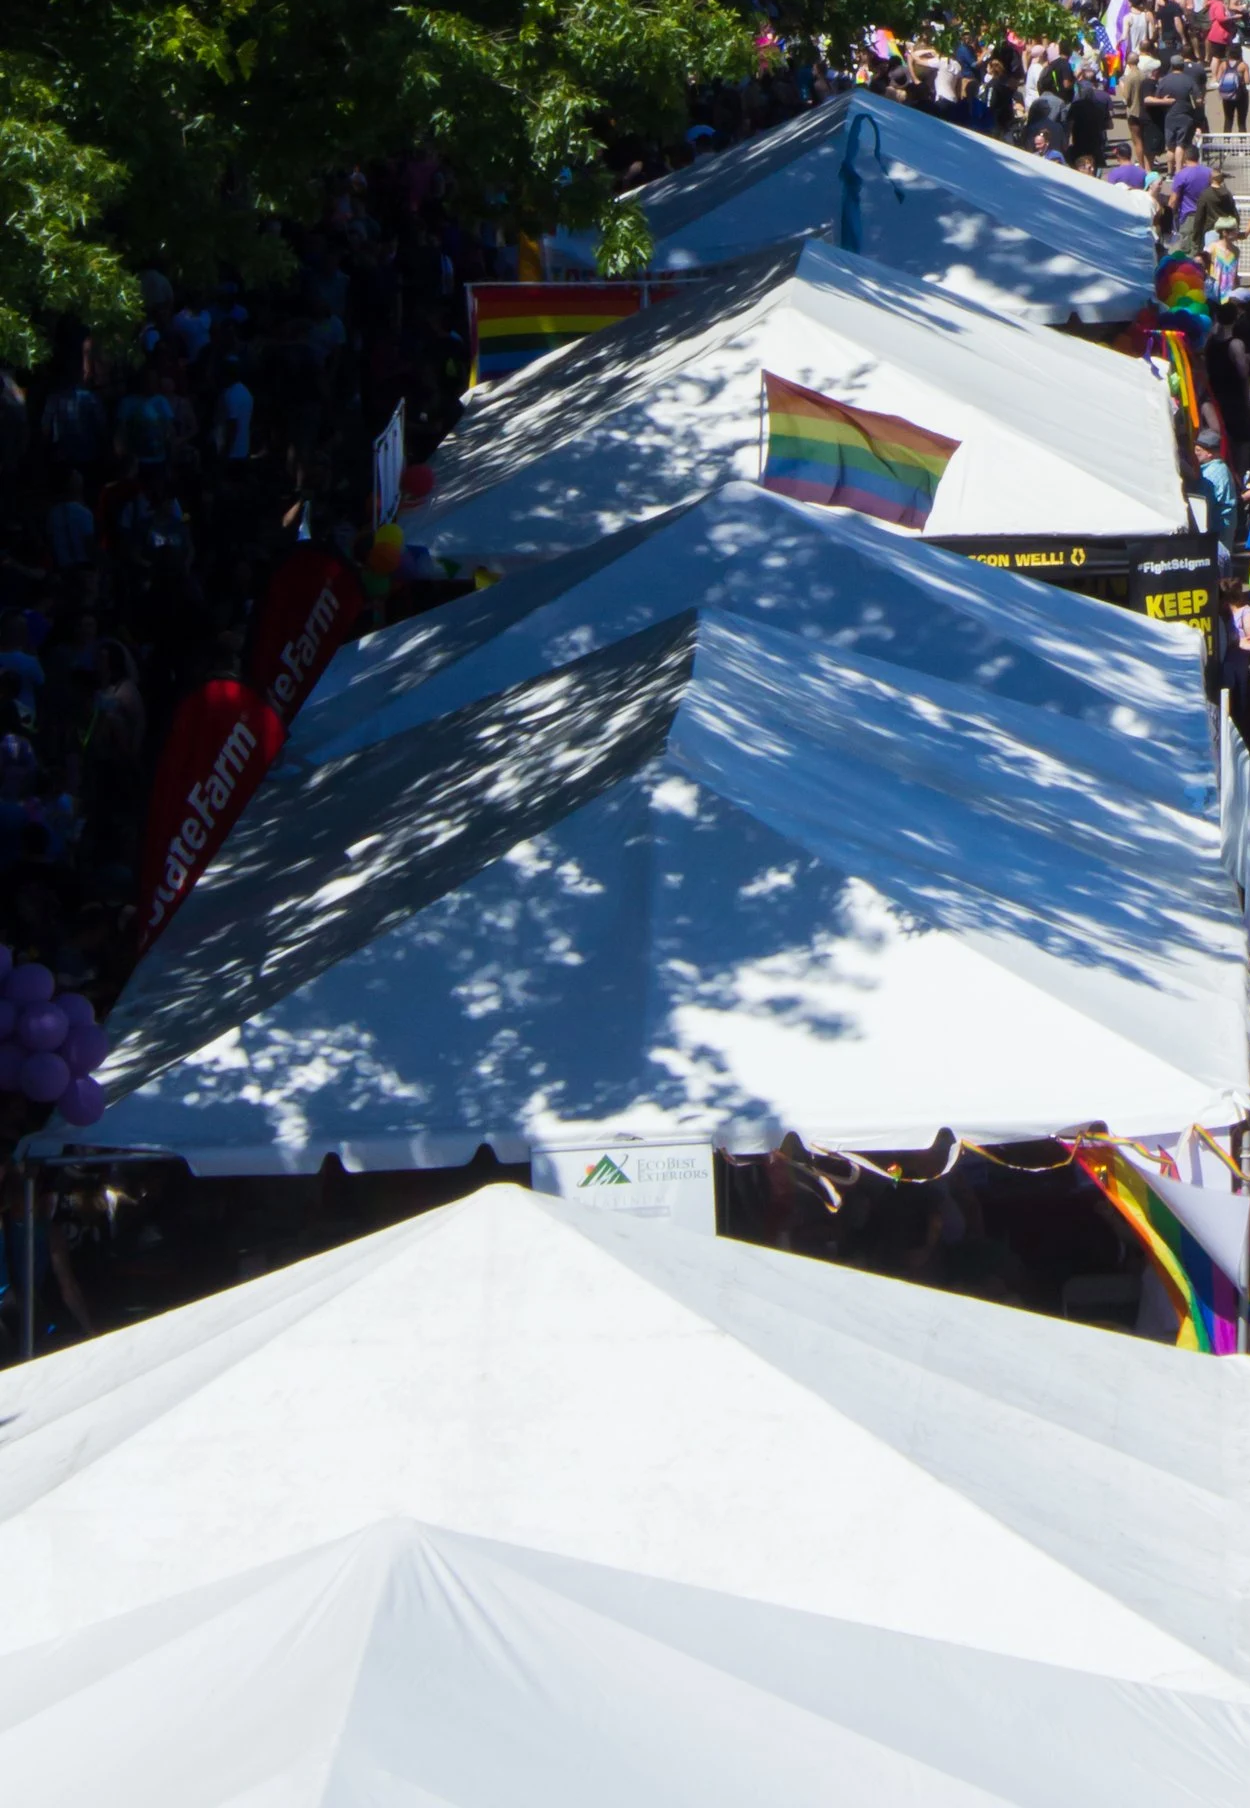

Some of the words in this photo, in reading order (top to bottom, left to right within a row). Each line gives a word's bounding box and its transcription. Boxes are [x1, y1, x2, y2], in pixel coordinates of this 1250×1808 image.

[967, 553, 1010, 567] GON
[1014, 551, 1064, 567] WELL!
[1138, 556, 1211, 574] #FightStigma
[1145, 589, 1208, 619] KEEP
